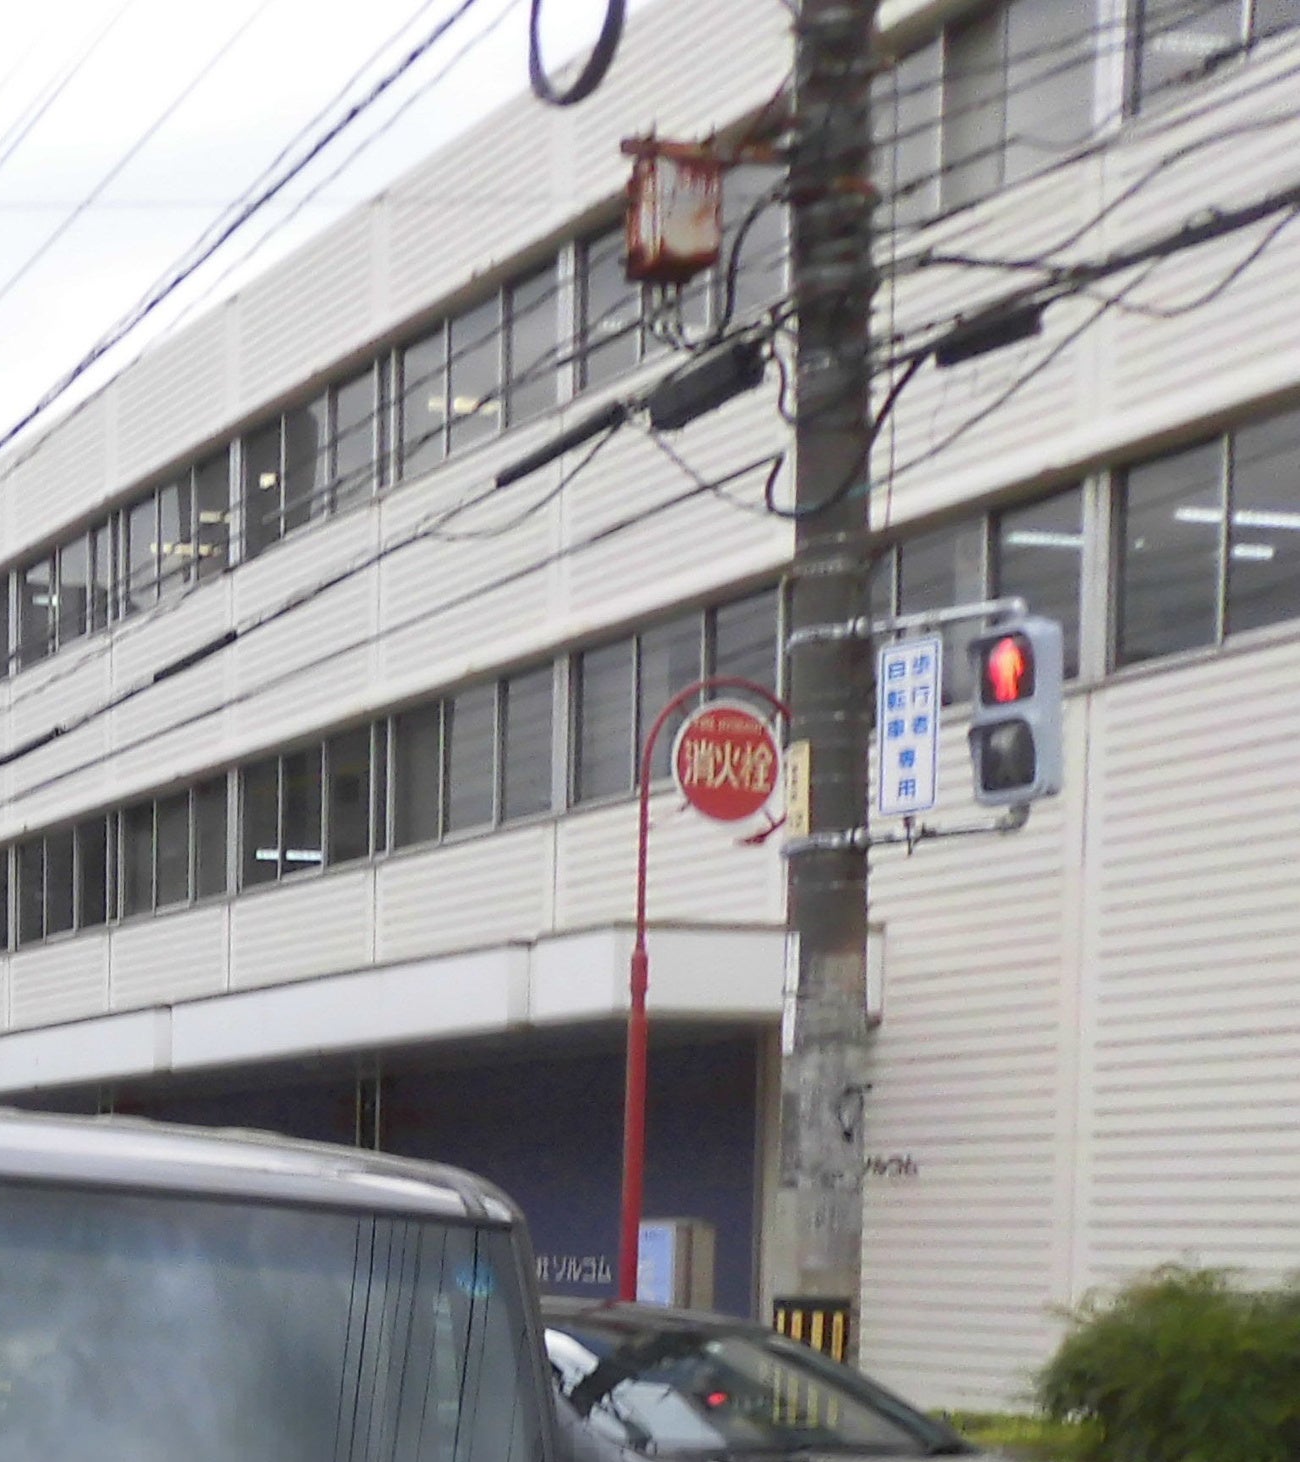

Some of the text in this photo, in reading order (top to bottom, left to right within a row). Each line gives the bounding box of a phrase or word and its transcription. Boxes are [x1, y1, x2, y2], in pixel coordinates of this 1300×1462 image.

[887, 660, 906, 738] 自転車
[912, 654, 931, 735] 歩行者
[683, 738, 774, 794] 消火栓
[898, 748, 916, 799] 専用
